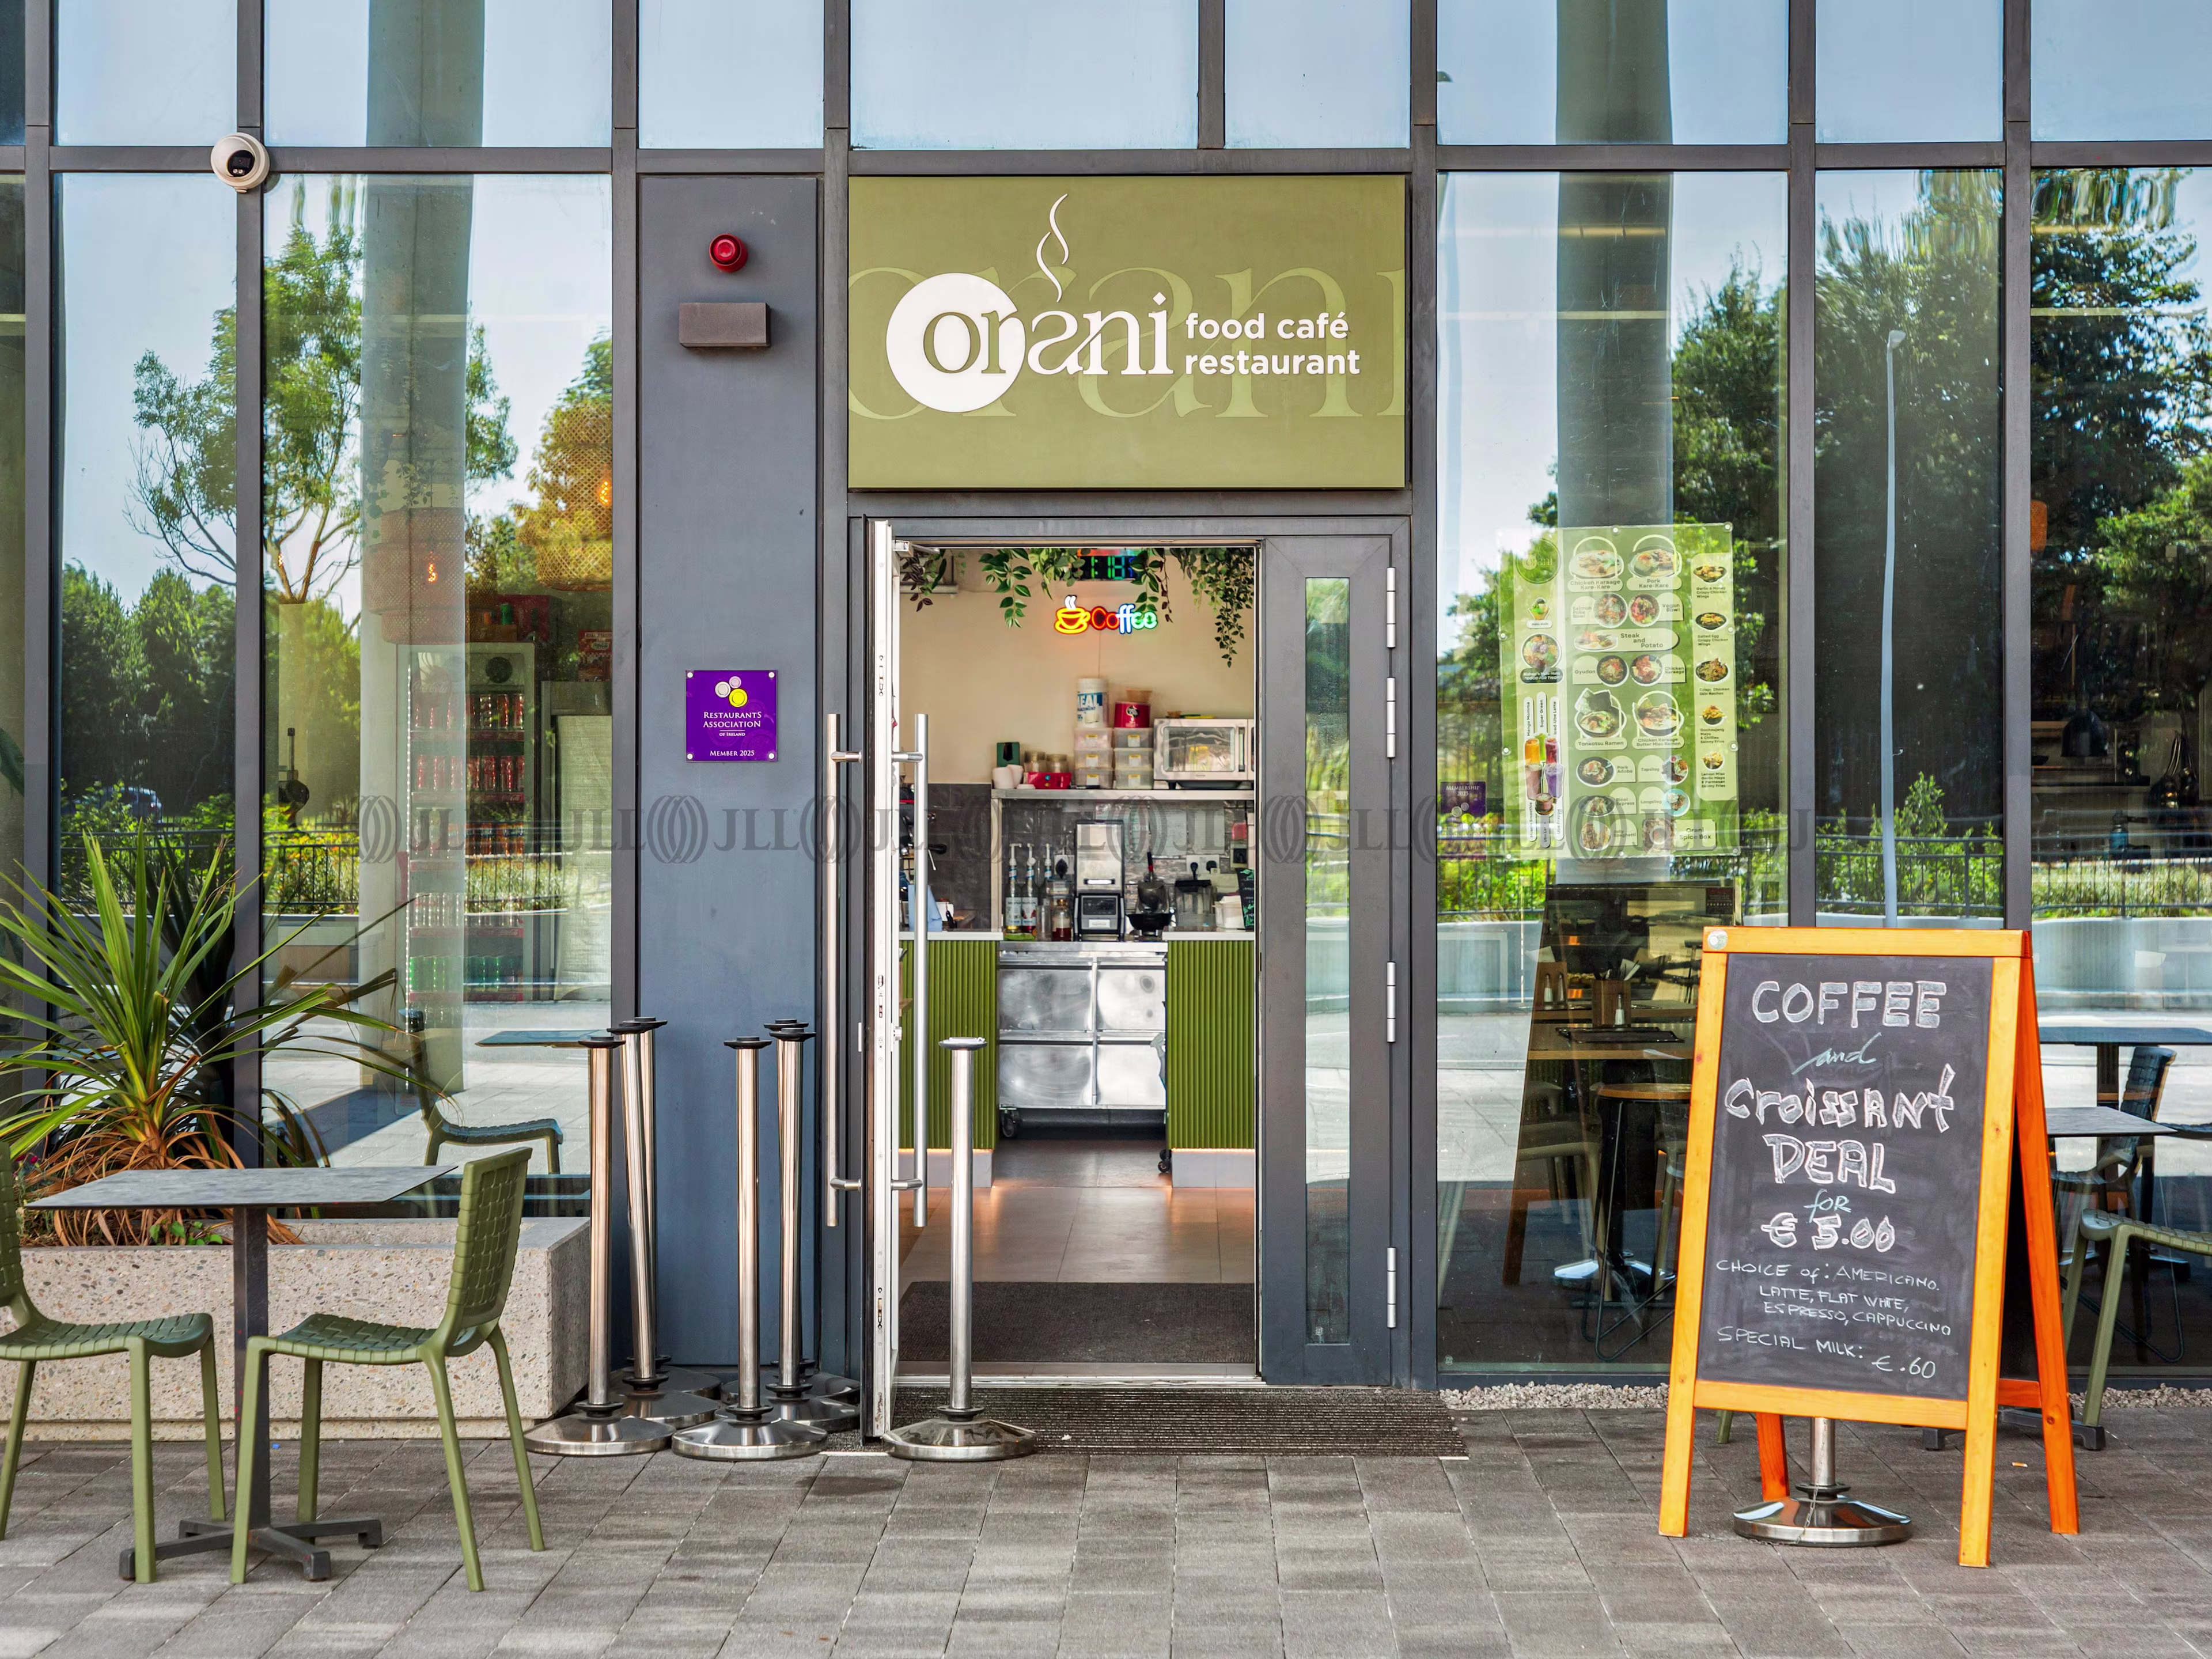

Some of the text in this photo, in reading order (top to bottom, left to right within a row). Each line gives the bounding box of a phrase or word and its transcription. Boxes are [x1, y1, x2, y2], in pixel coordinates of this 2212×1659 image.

[922, 291, 1174, 376] orani
[1185, 310, 1350, 340] food café
[1184, 349, 1361, 376] restaurant
[1090, 604, 1158, 634] Coffee
[1752, 980, 1948, 1028] COFFEE
[1792, 1032, 1883, 1075] and
[1762, 1134, 1896, 1194] DEAL
[1811, 1214, 1896, 1253] 5.00
[1716, 1260, 1793, 1278] CHOICE
[1817, 1291, 1858, 1305] FLAT
[1717, 1326, 1806, 1351] SPECIAL
[1853, 1311, 1952, 1336] CAPPUCCINO
